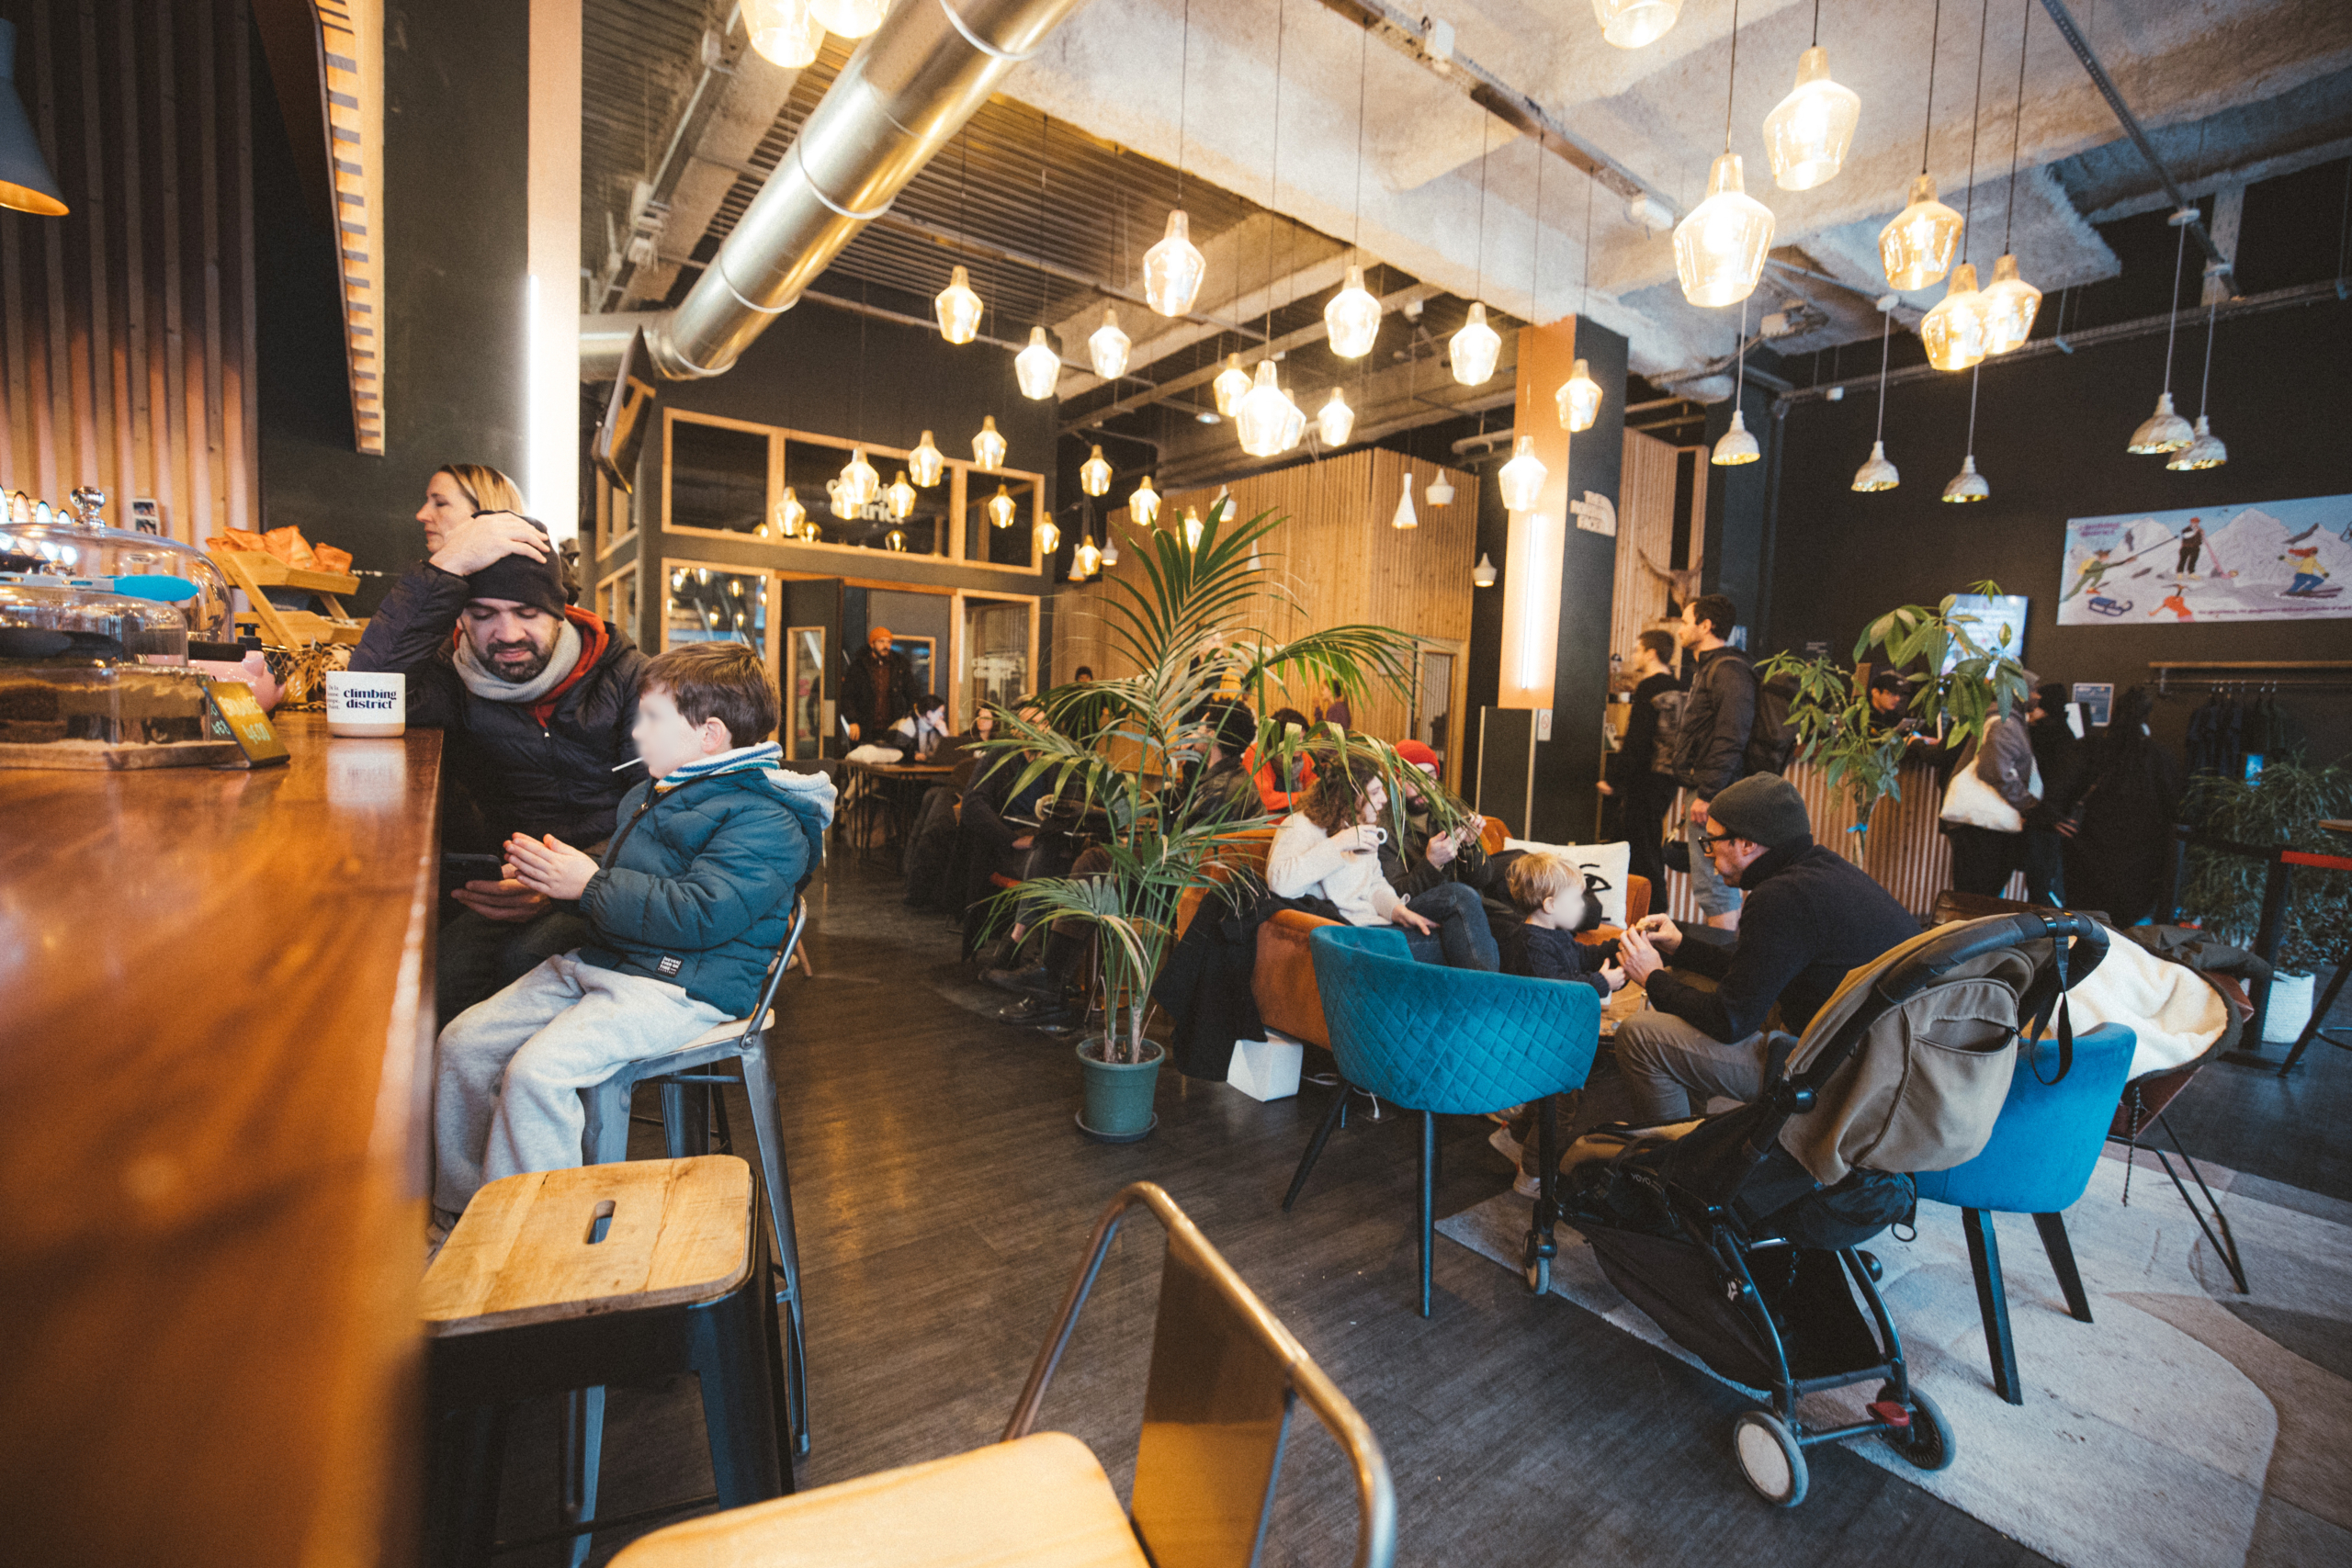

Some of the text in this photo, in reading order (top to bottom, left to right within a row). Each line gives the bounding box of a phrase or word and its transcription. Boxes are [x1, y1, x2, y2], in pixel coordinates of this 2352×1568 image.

[343, 688, 397, 701] climbing
[345, 699, 392, 709] district
[1630, 1172, 1651, 1186] YOYO
